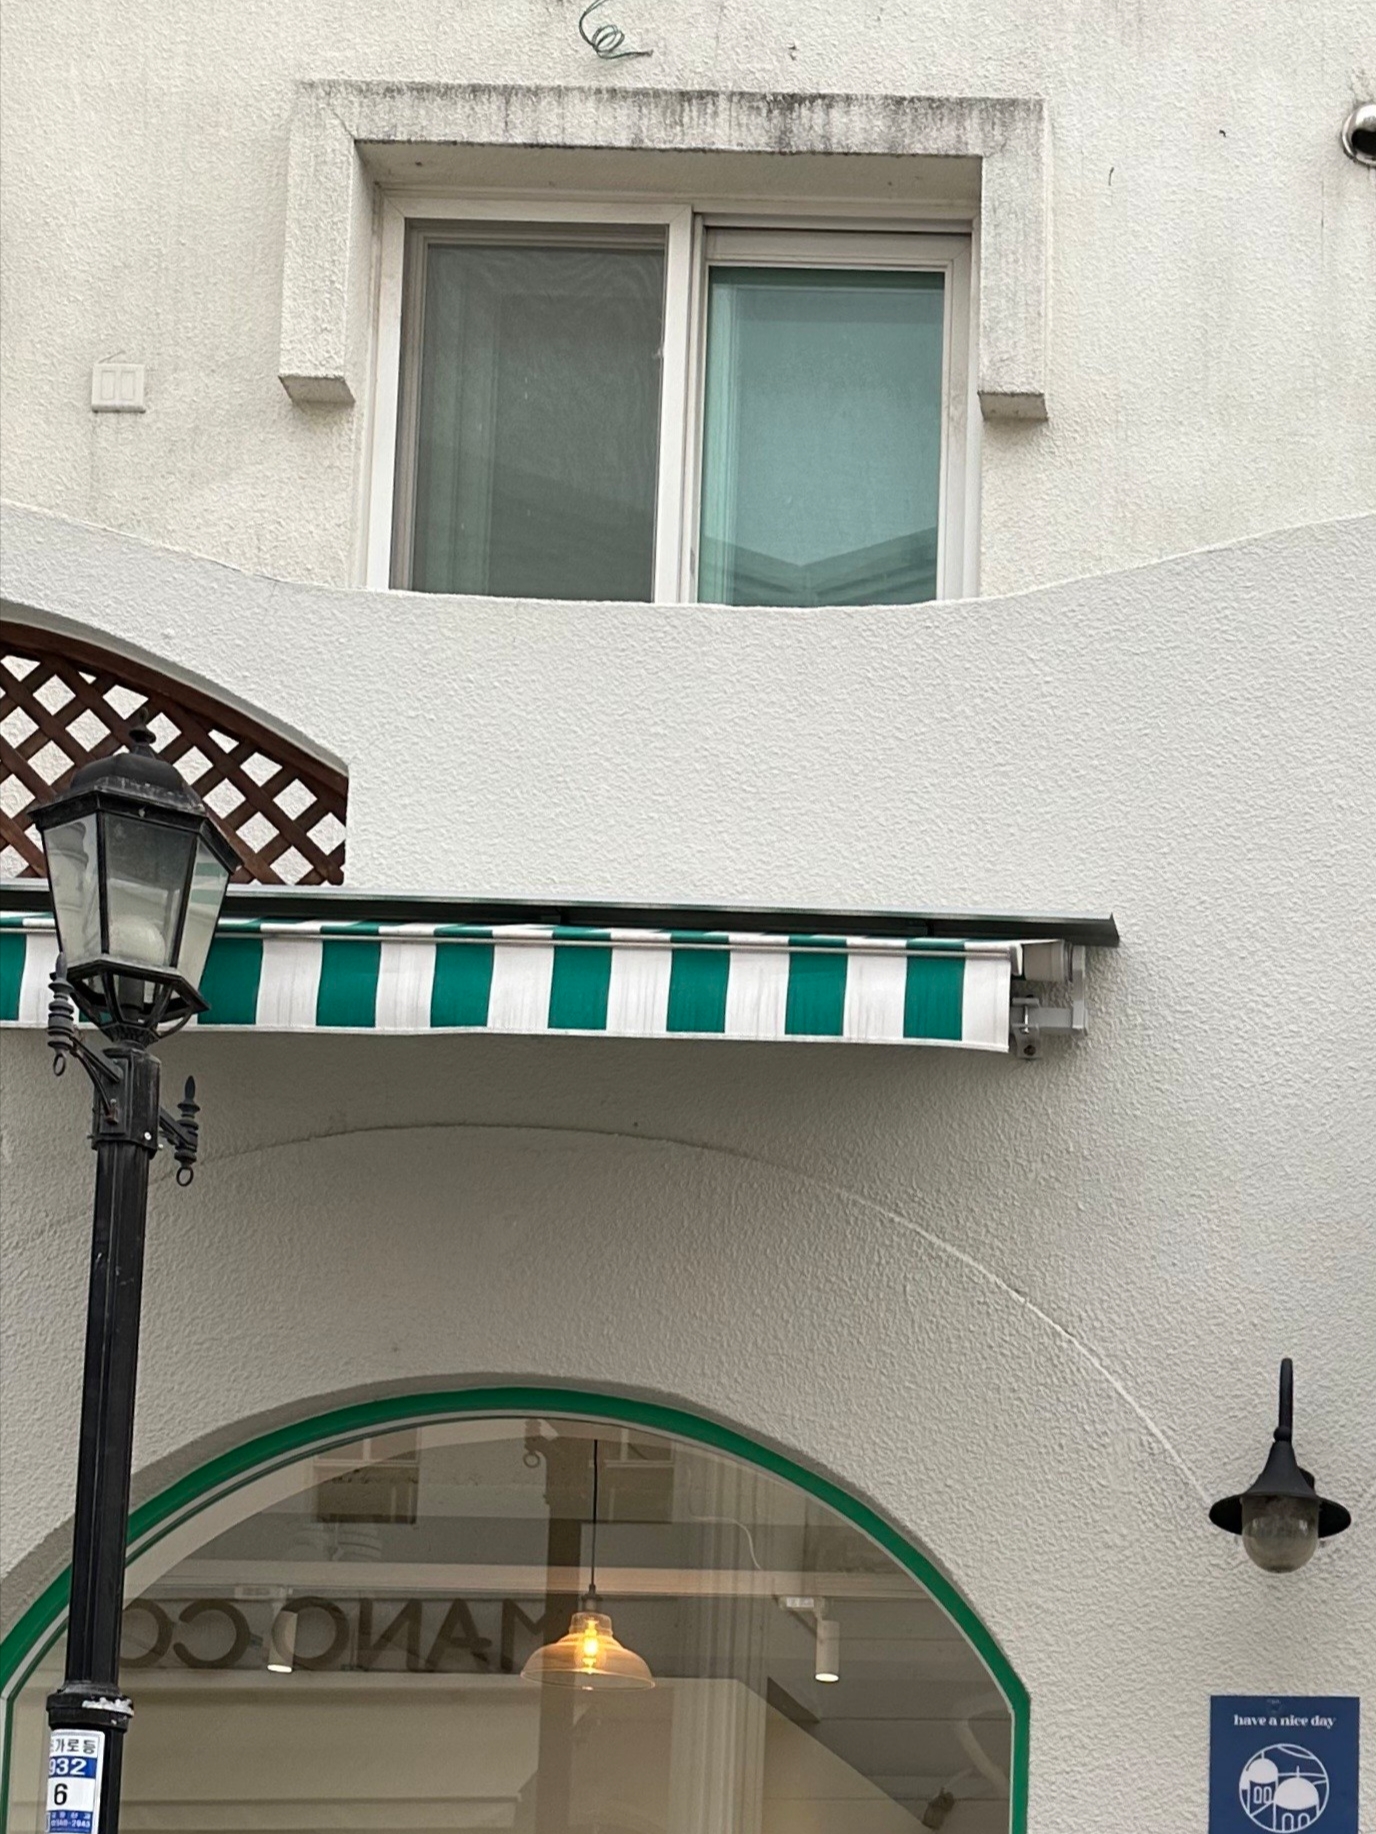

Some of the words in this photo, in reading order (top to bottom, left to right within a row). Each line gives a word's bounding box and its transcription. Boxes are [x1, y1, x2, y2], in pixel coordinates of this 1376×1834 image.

[1233, 1714, 1267, 1726] have
[1268, 1716, 1278, 1726] a
[1280, 1714, 1309, 1727] nice
[1310, 1715, 1337, 1730] day
[51, 1737, 97, 1755] 가로등
[53, 1783, 69, 1806] 6
